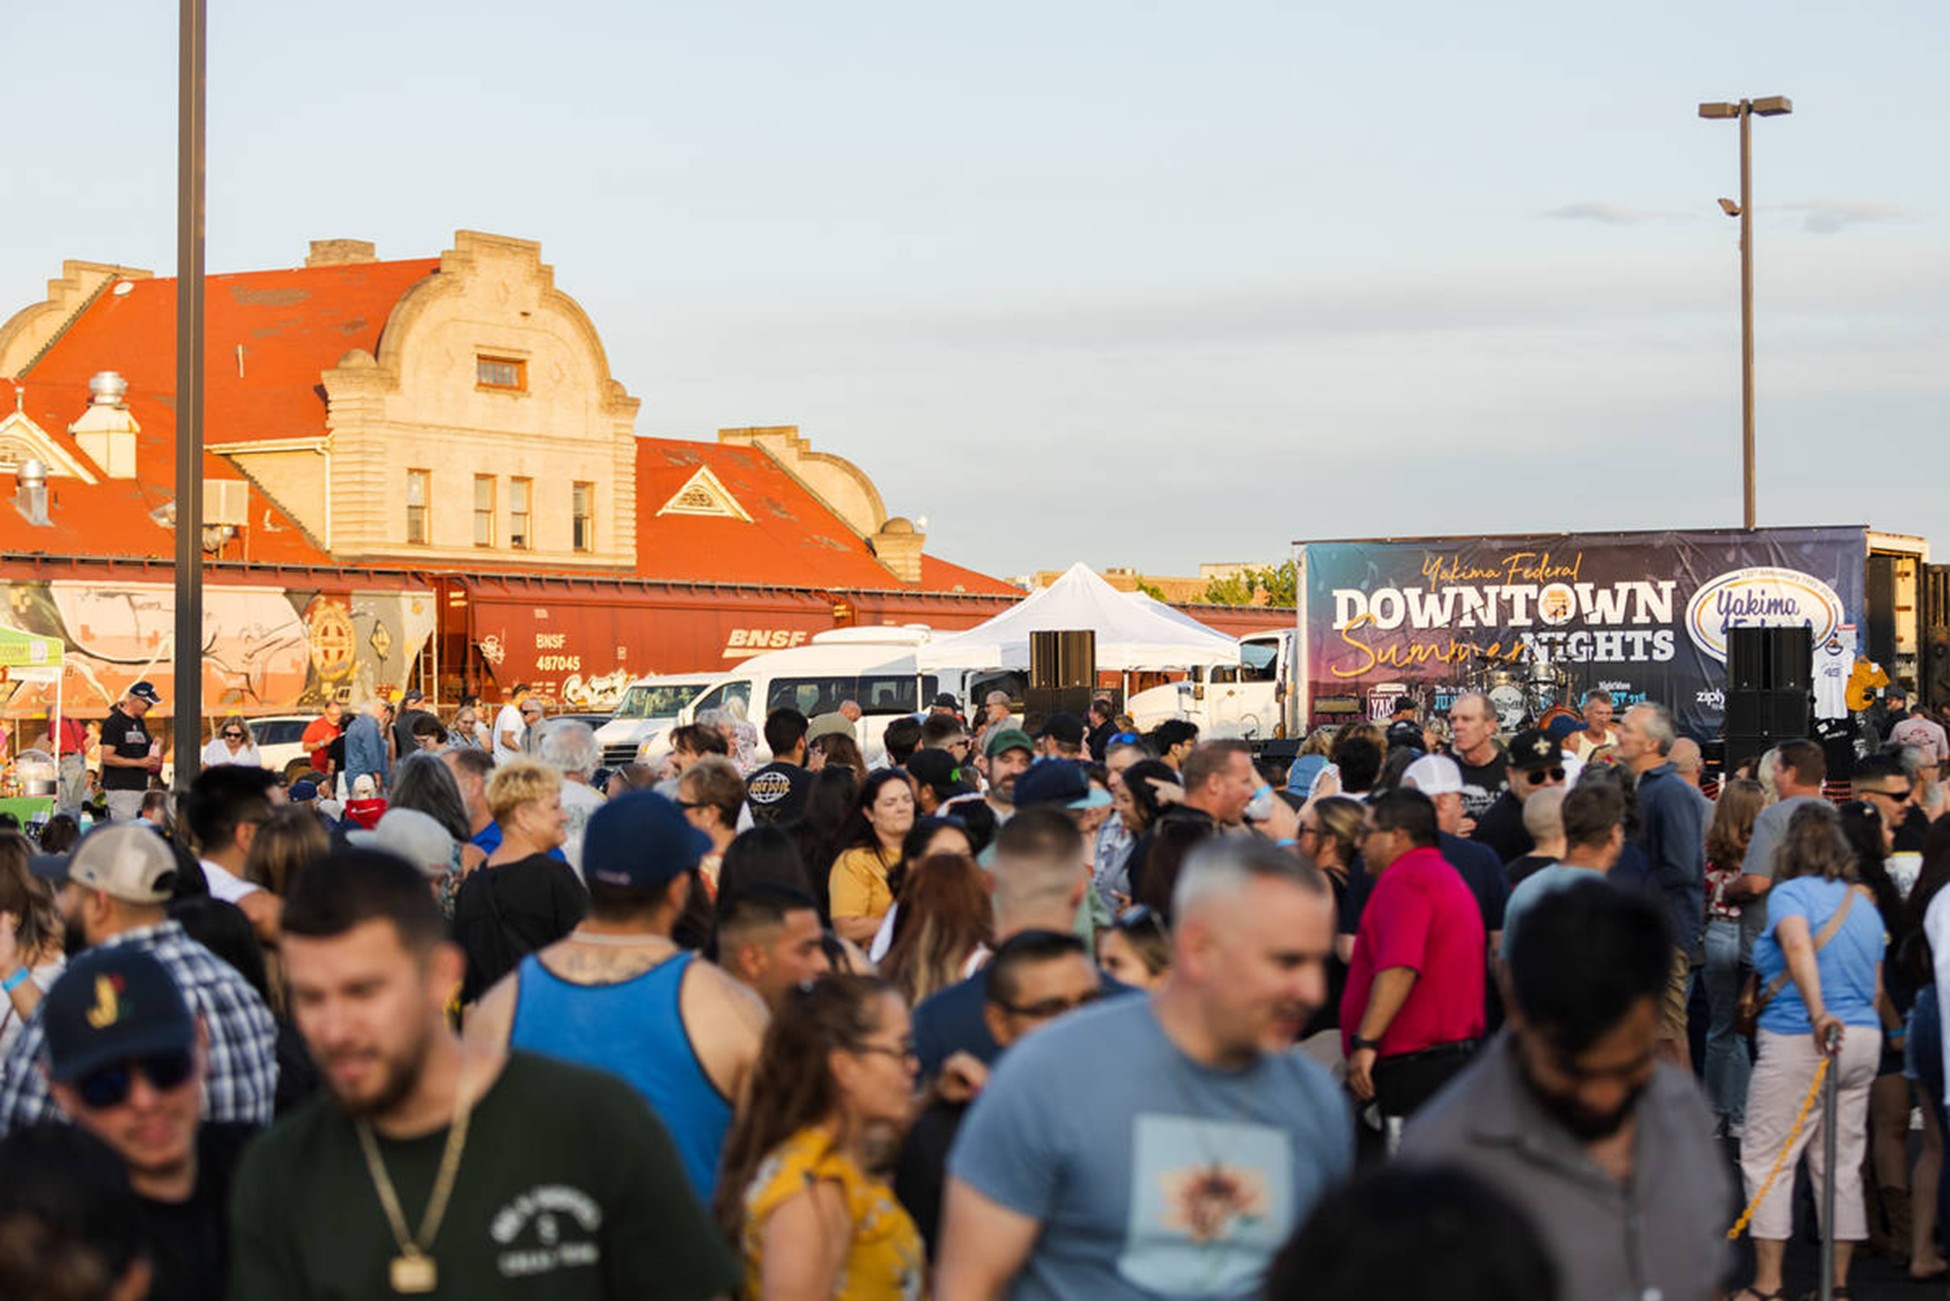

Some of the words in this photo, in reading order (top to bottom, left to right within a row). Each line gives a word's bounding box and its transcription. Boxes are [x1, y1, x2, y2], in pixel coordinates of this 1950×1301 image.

[1422, 555, 1501, 593] Yakima
[1502, 552, 1582, 585] Federal
[1332, 581, 1676, 630] DOWNTOWN
[1716, 589, 1800, 635] Yakima
[535, 633, 566, 649] BNSF
[727, 629, 808, 648] BNSF
[1520, 630, 1676, 664] NIGHTS
[536, 656, 580, 671] 487045
